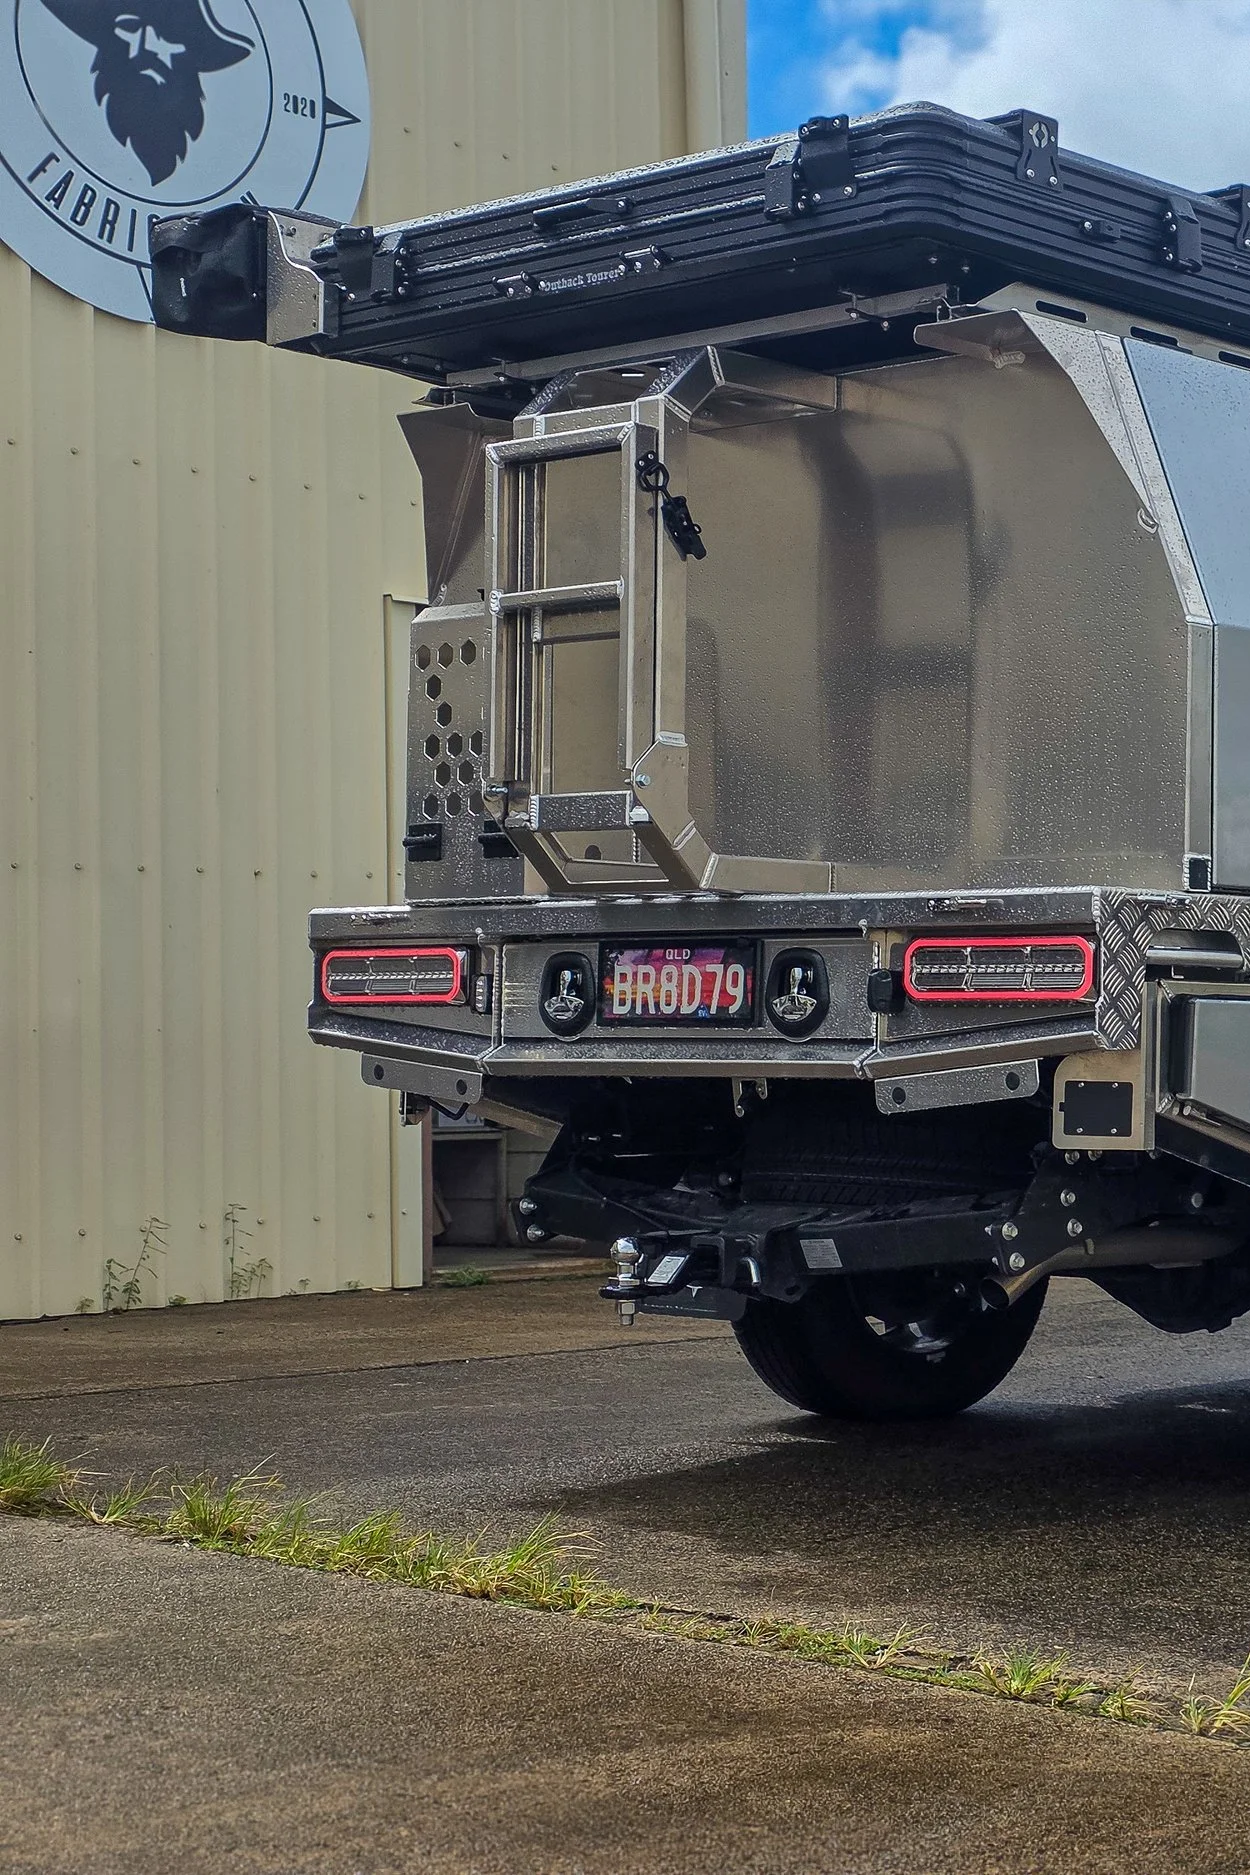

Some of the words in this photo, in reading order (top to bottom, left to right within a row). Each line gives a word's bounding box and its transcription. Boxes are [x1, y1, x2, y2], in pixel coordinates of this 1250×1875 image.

[283, 92, 316, 119] 2020
[586, 268, 620, 283] Tourer
[665, 948, 691, 960] QLD
[612, 963, 745, 1015] BR8D79
